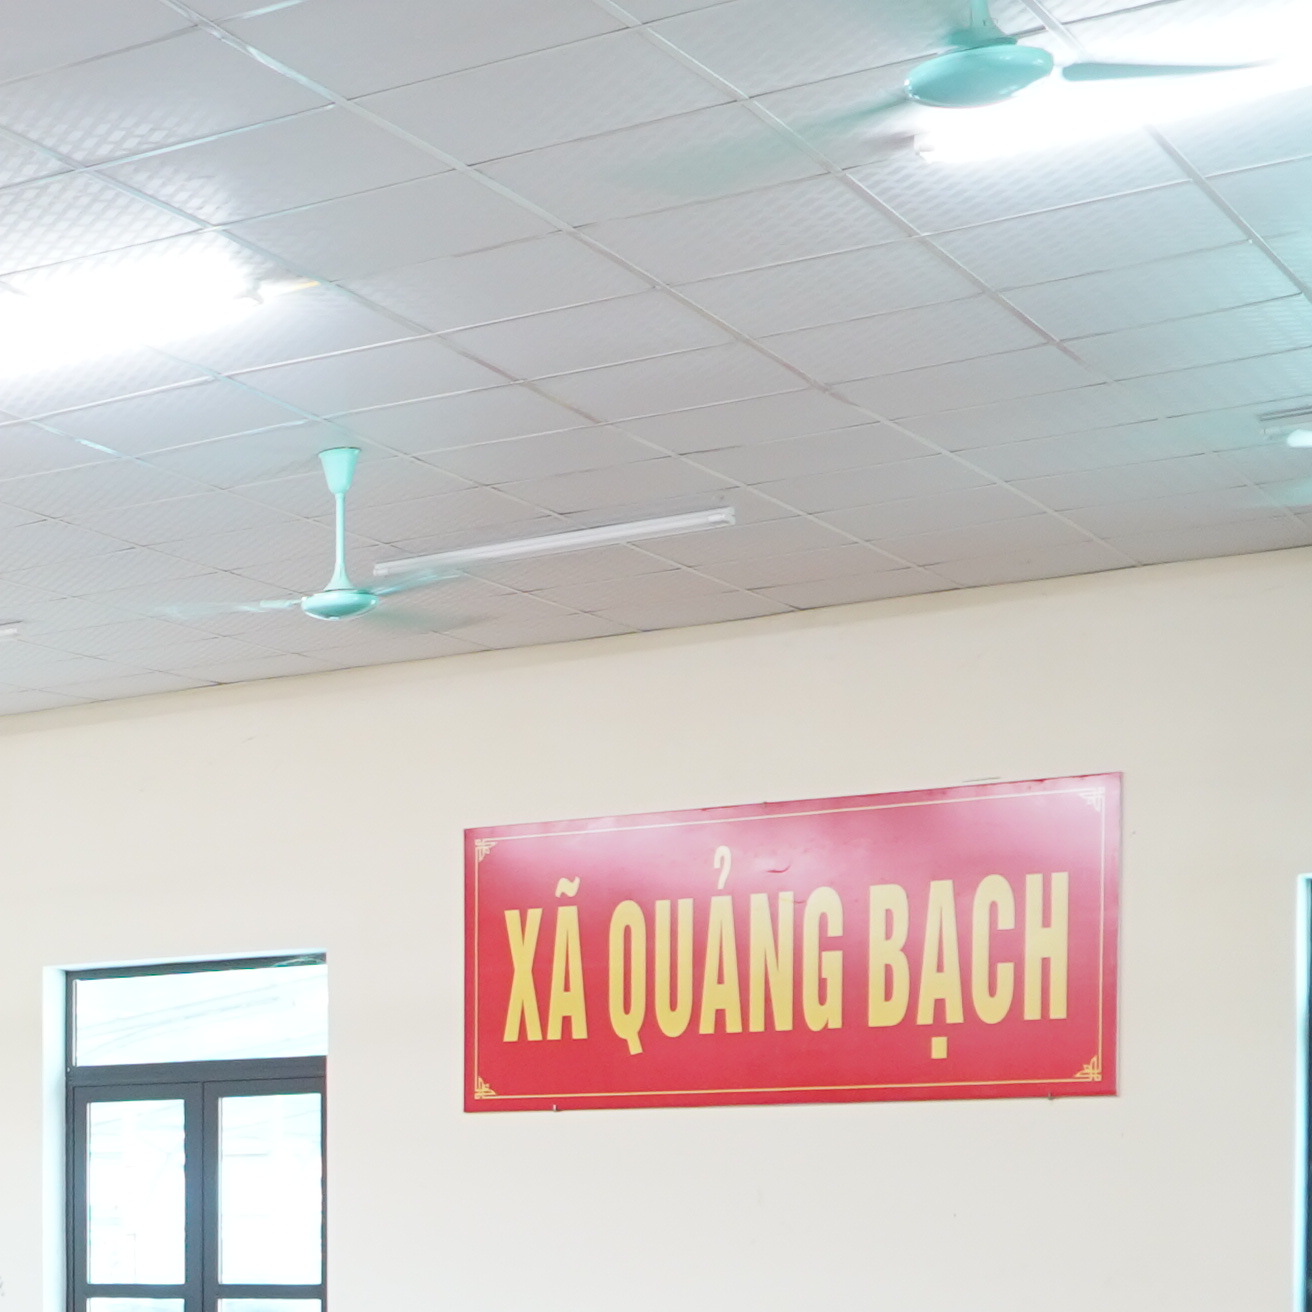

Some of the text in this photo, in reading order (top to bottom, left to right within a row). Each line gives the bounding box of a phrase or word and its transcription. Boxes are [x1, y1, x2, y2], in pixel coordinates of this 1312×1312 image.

[503, 845, 1070, 1060] XÃ QUẢNG BẠCH
